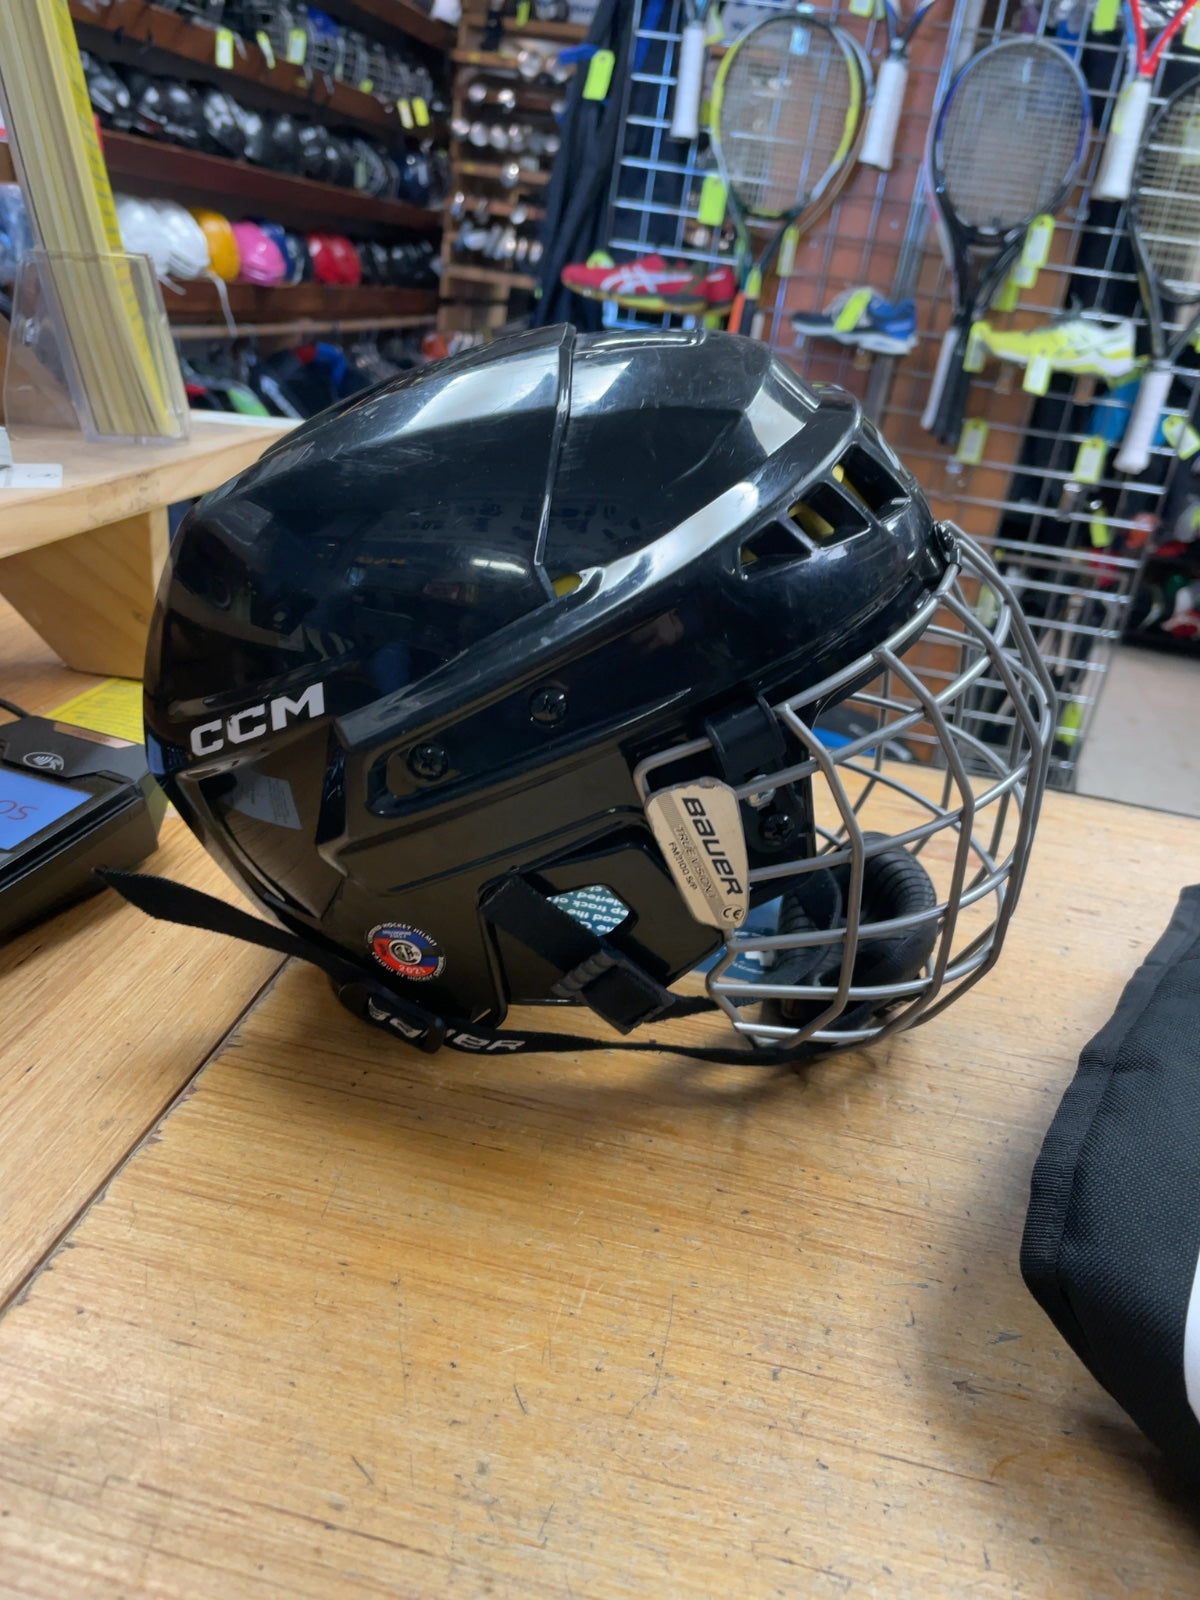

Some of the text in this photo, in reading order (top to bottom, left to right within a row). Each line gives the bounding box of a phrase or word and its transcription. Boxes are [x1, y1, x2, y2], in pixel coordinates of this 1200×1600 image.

[190, 682, 325, 756] CCM
[0, 799, 39, 821] OS
[682, 797, 743, 895] BAUER
[566, 908, 590, 919] the
[572, 899, 608, 912] track
